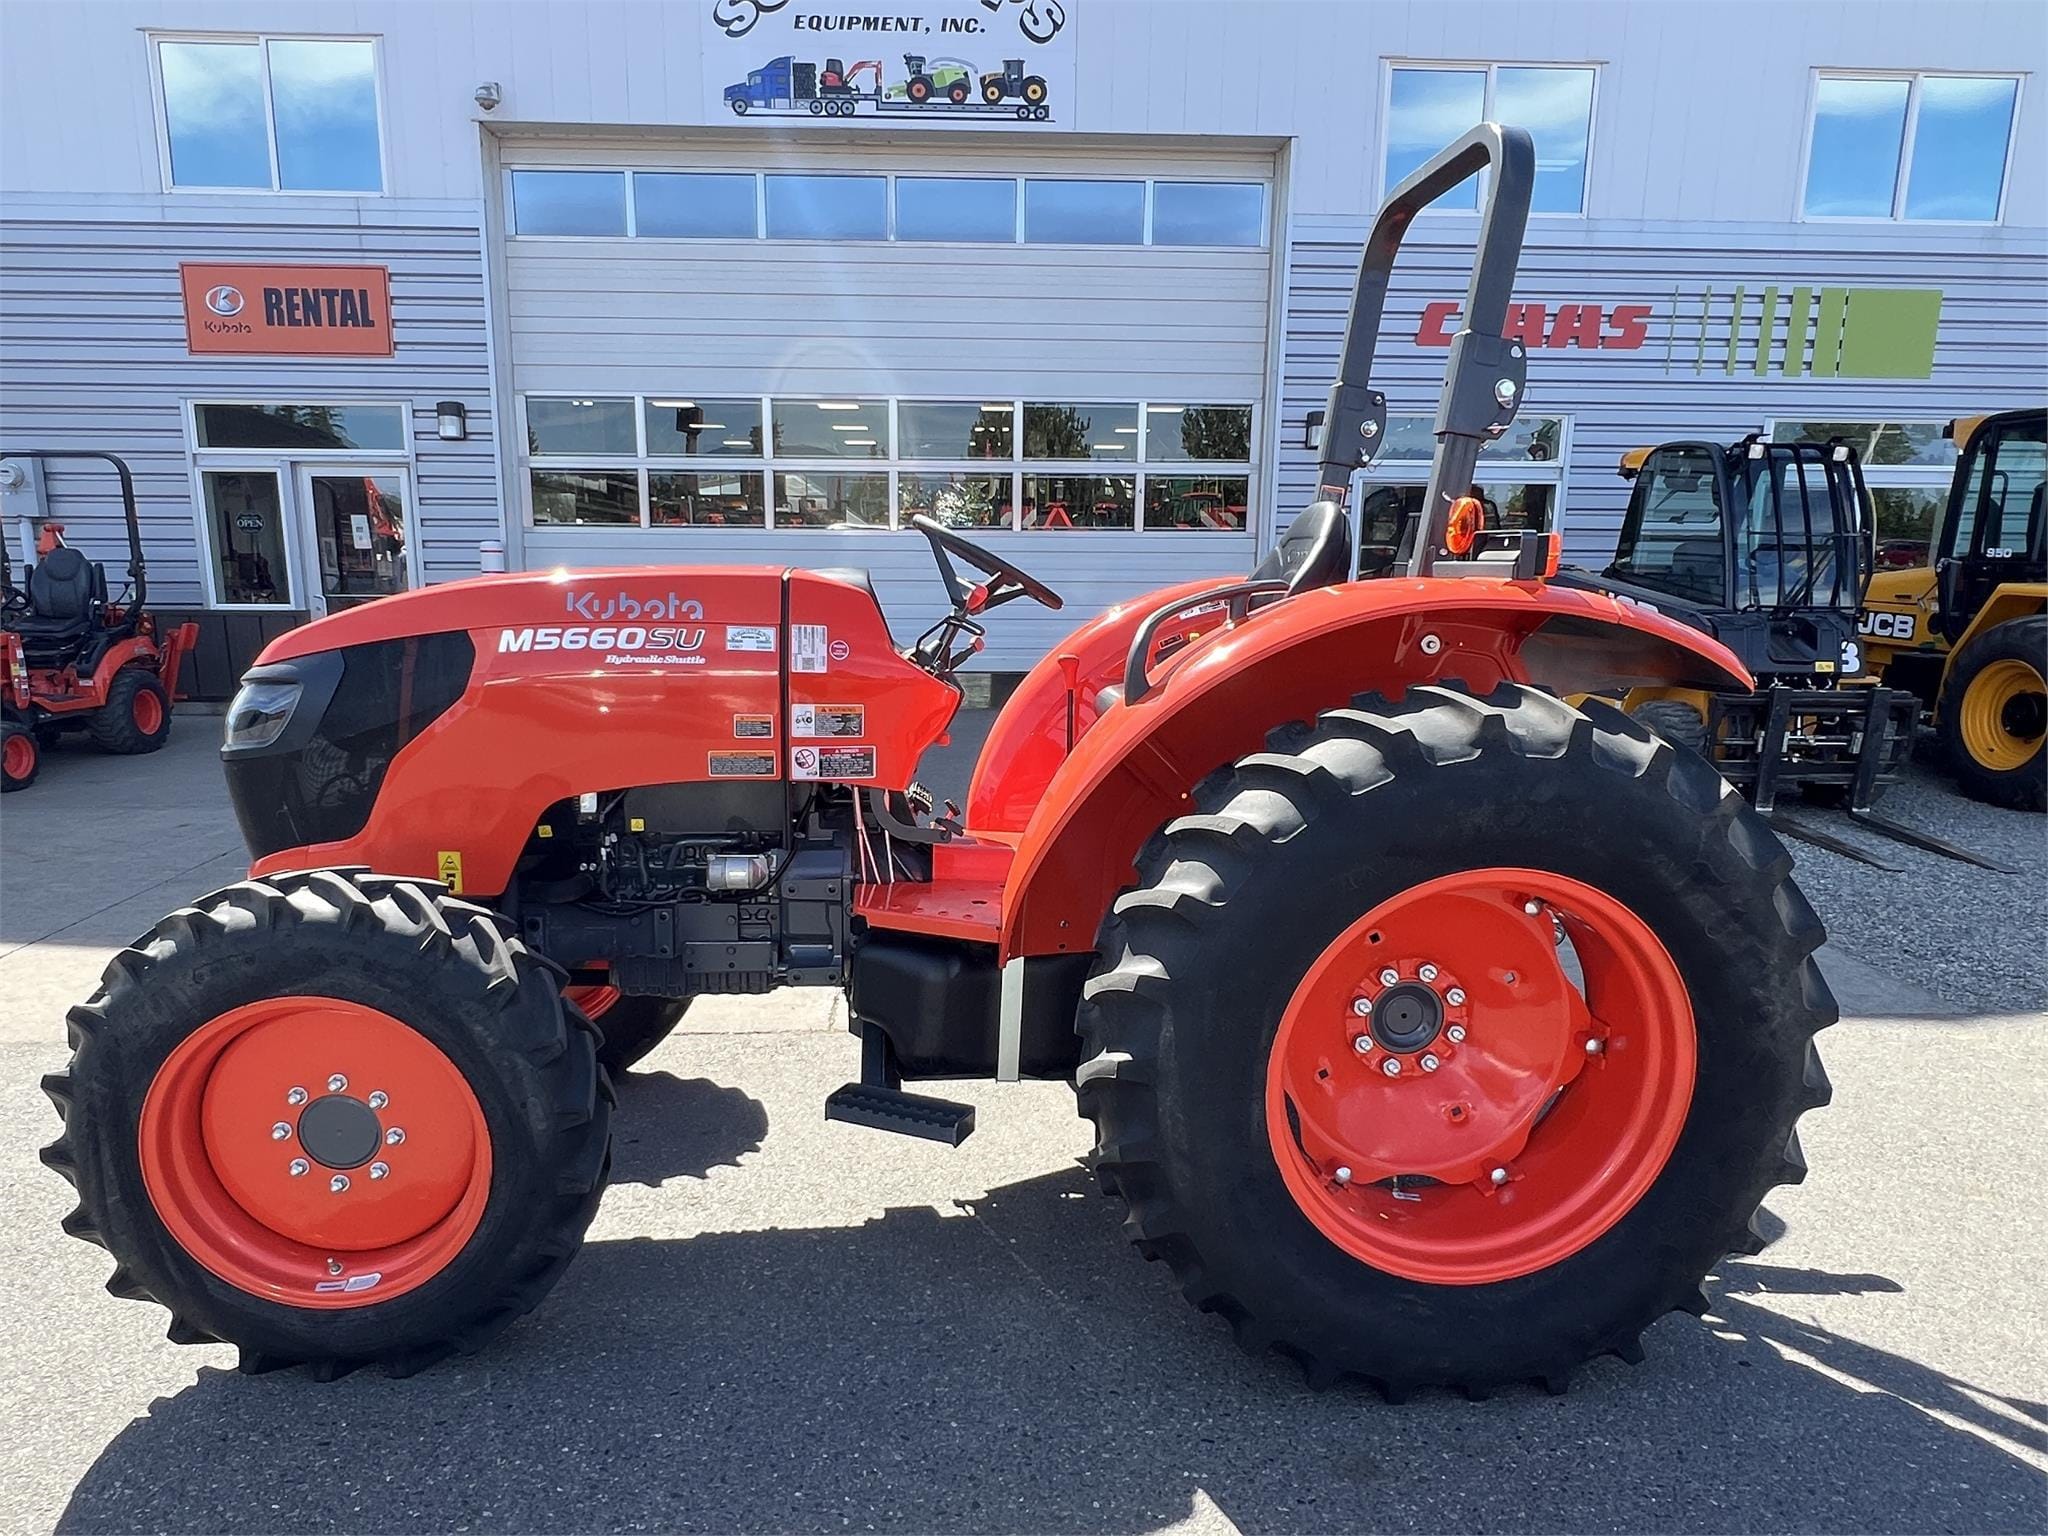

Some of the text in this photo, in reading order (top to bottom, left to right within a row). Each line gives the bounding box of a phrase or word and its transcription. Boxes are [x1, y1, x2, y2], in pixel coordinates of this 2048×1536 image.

[793, 14, 931, 35] EQUIPMENT,
[940, 17, 987, 34] INC.
[263, 287, 375, 328] RENTAL
[204, 320, 252, 334] Kubota
[1415, 302, 1653, 350] CAAS
[236, 519, 263, 528] OPEN
[1986, 547, 2013, 558] 950
[566, 592, 704, 620] Kubota
[1857, 612, 1915, 639] JCB
[498, 627, 706, 653] M5660SU
[605, 654, 706, 665] Hydraulic Shuttle
